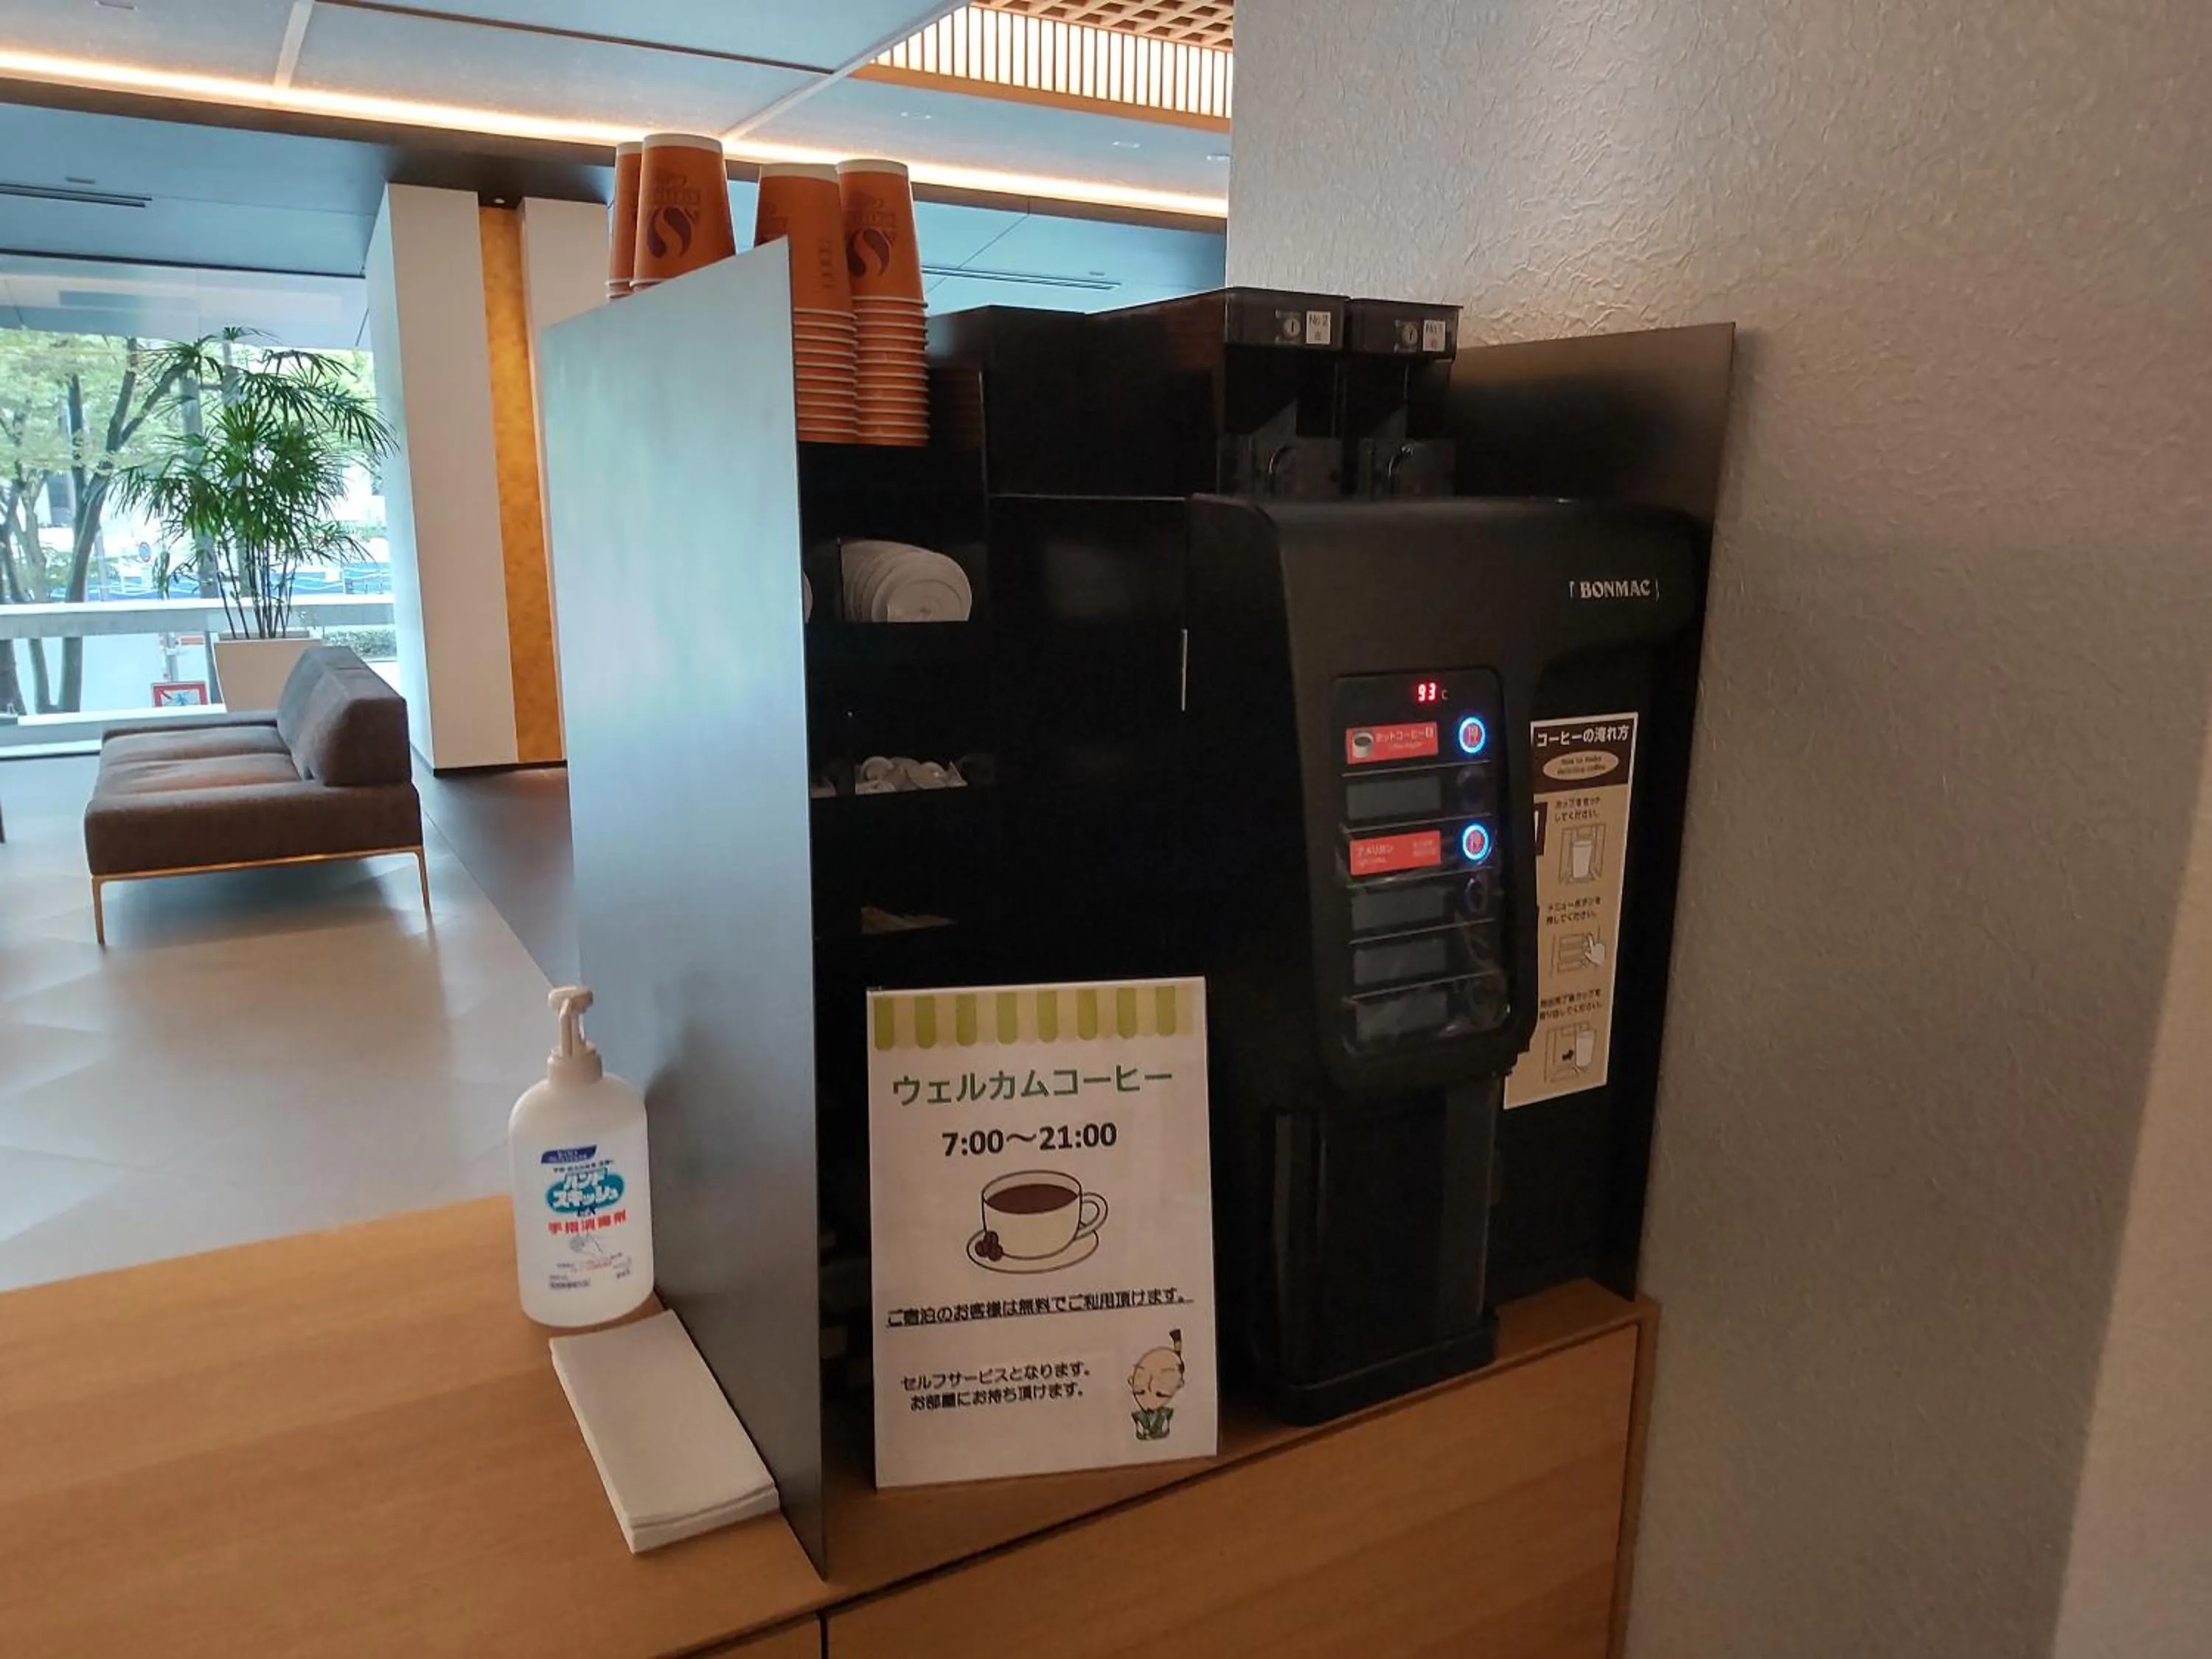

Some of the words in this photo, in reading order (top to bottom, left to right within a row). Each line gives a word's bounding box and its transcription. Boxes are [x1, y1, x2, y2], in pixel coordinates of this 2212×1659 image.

[1579, 580, 1651, 598] BONMAC
[1417, 682, 1436, 702] 93
[892, 1065, 1174, 1106] ウェルカムコーヒー
[900, 1360, 1091, 1391] セルフサービスとなります。
[911, 1382, 1084, 1411] お部屋にお持ち頂けます。
